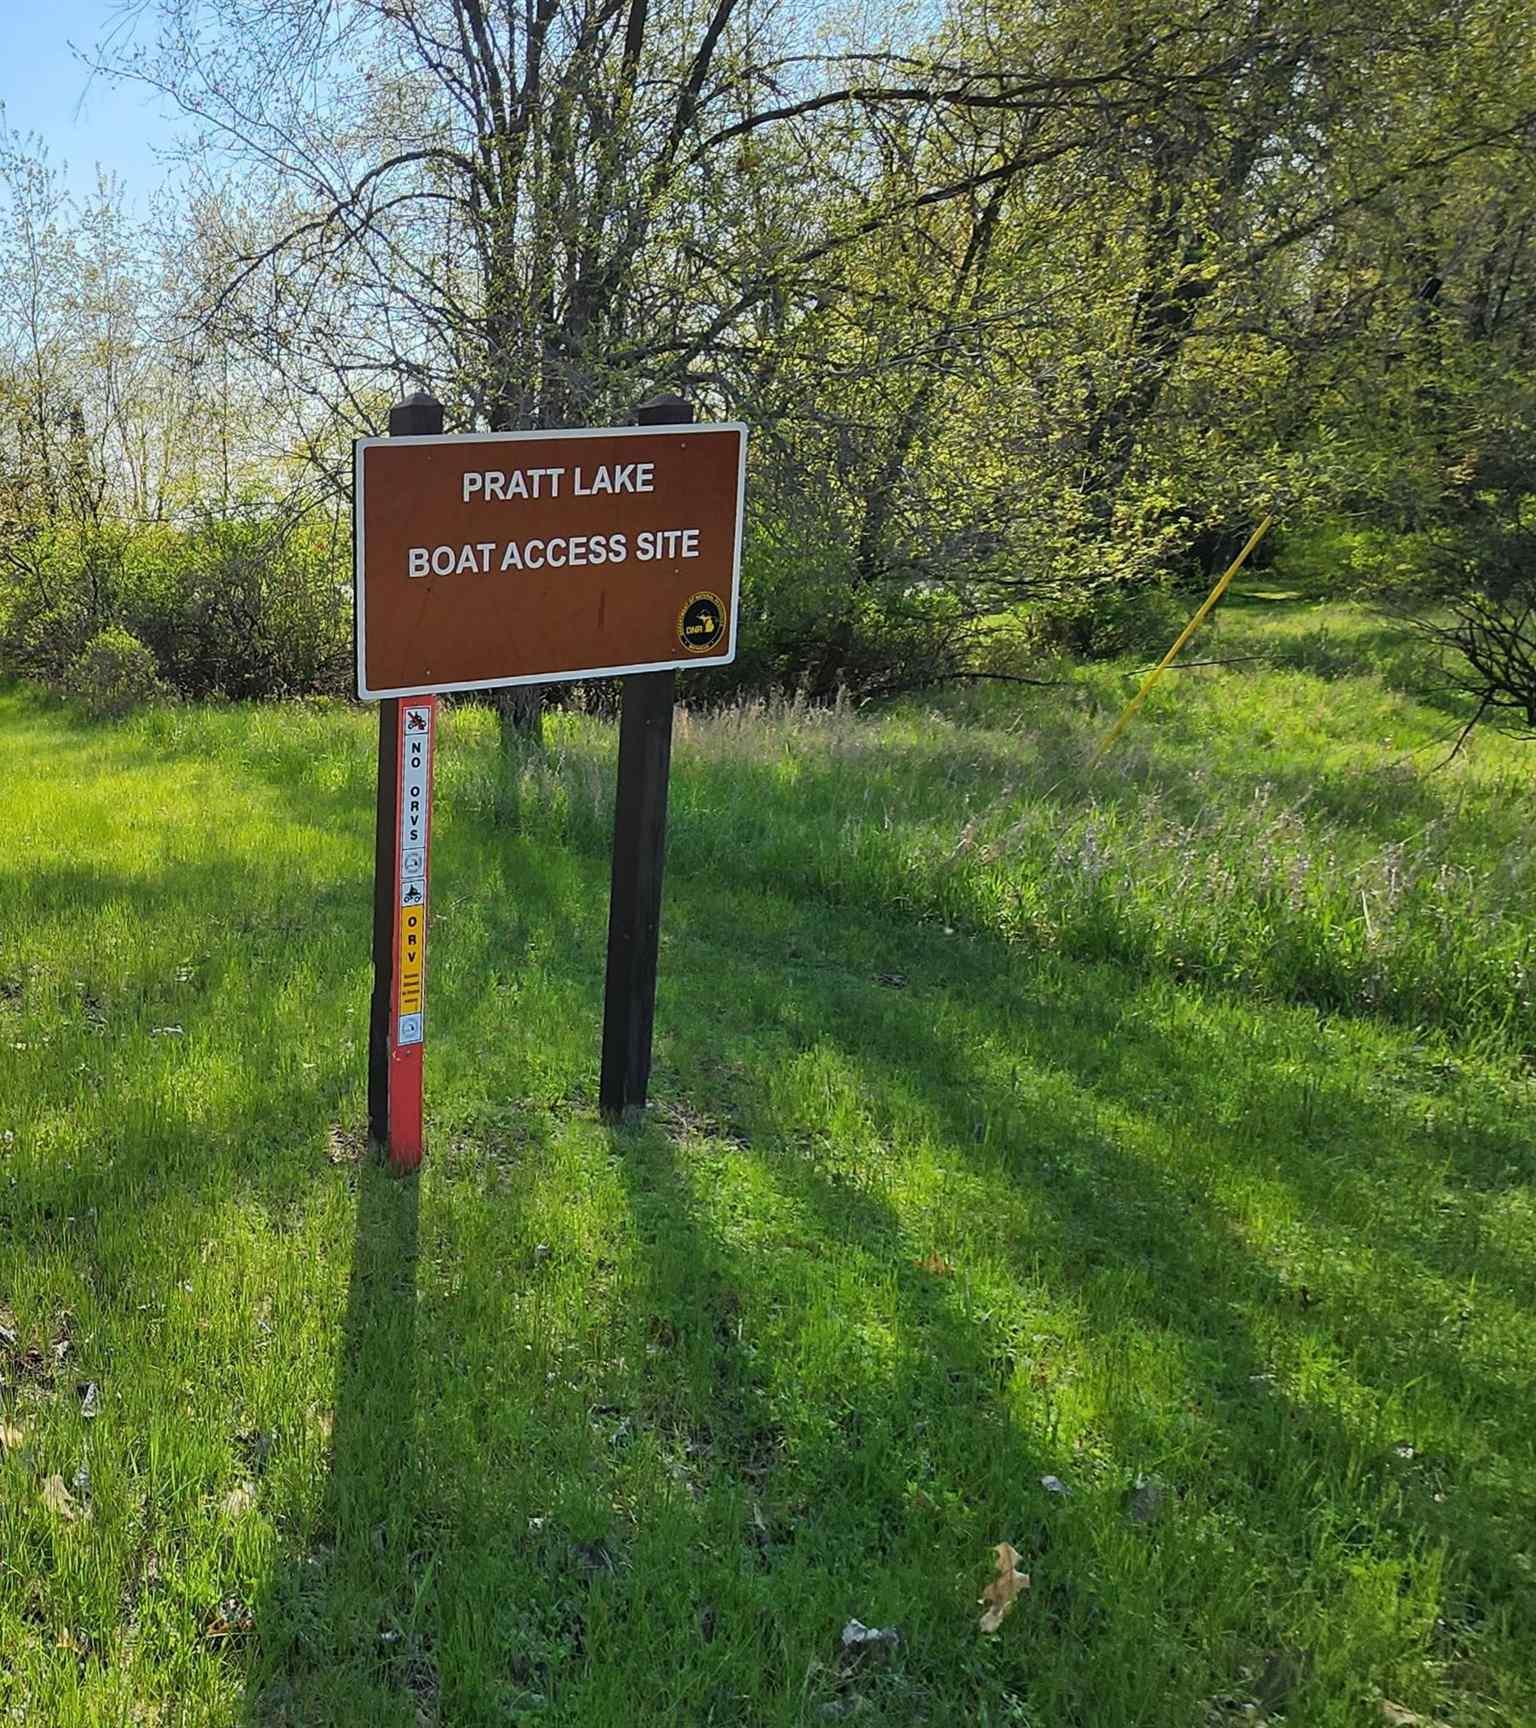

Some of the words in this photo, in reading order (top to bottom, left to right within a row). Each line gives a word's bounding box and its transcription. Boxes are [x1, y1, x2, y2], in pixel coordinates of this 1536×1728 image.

[464, 467, 564, 502] PRATT
[574, 463, 655, 496] LAKE
[408, 543, 496, 578] BOAT
[500, 533, 627, 571] ACCESS
[636, 528, 700, 560] SITE
[411, 742, 421, 768] NO
[410, 786, 420, 841] ORVS
[408, 916, 417, 962] ORV
